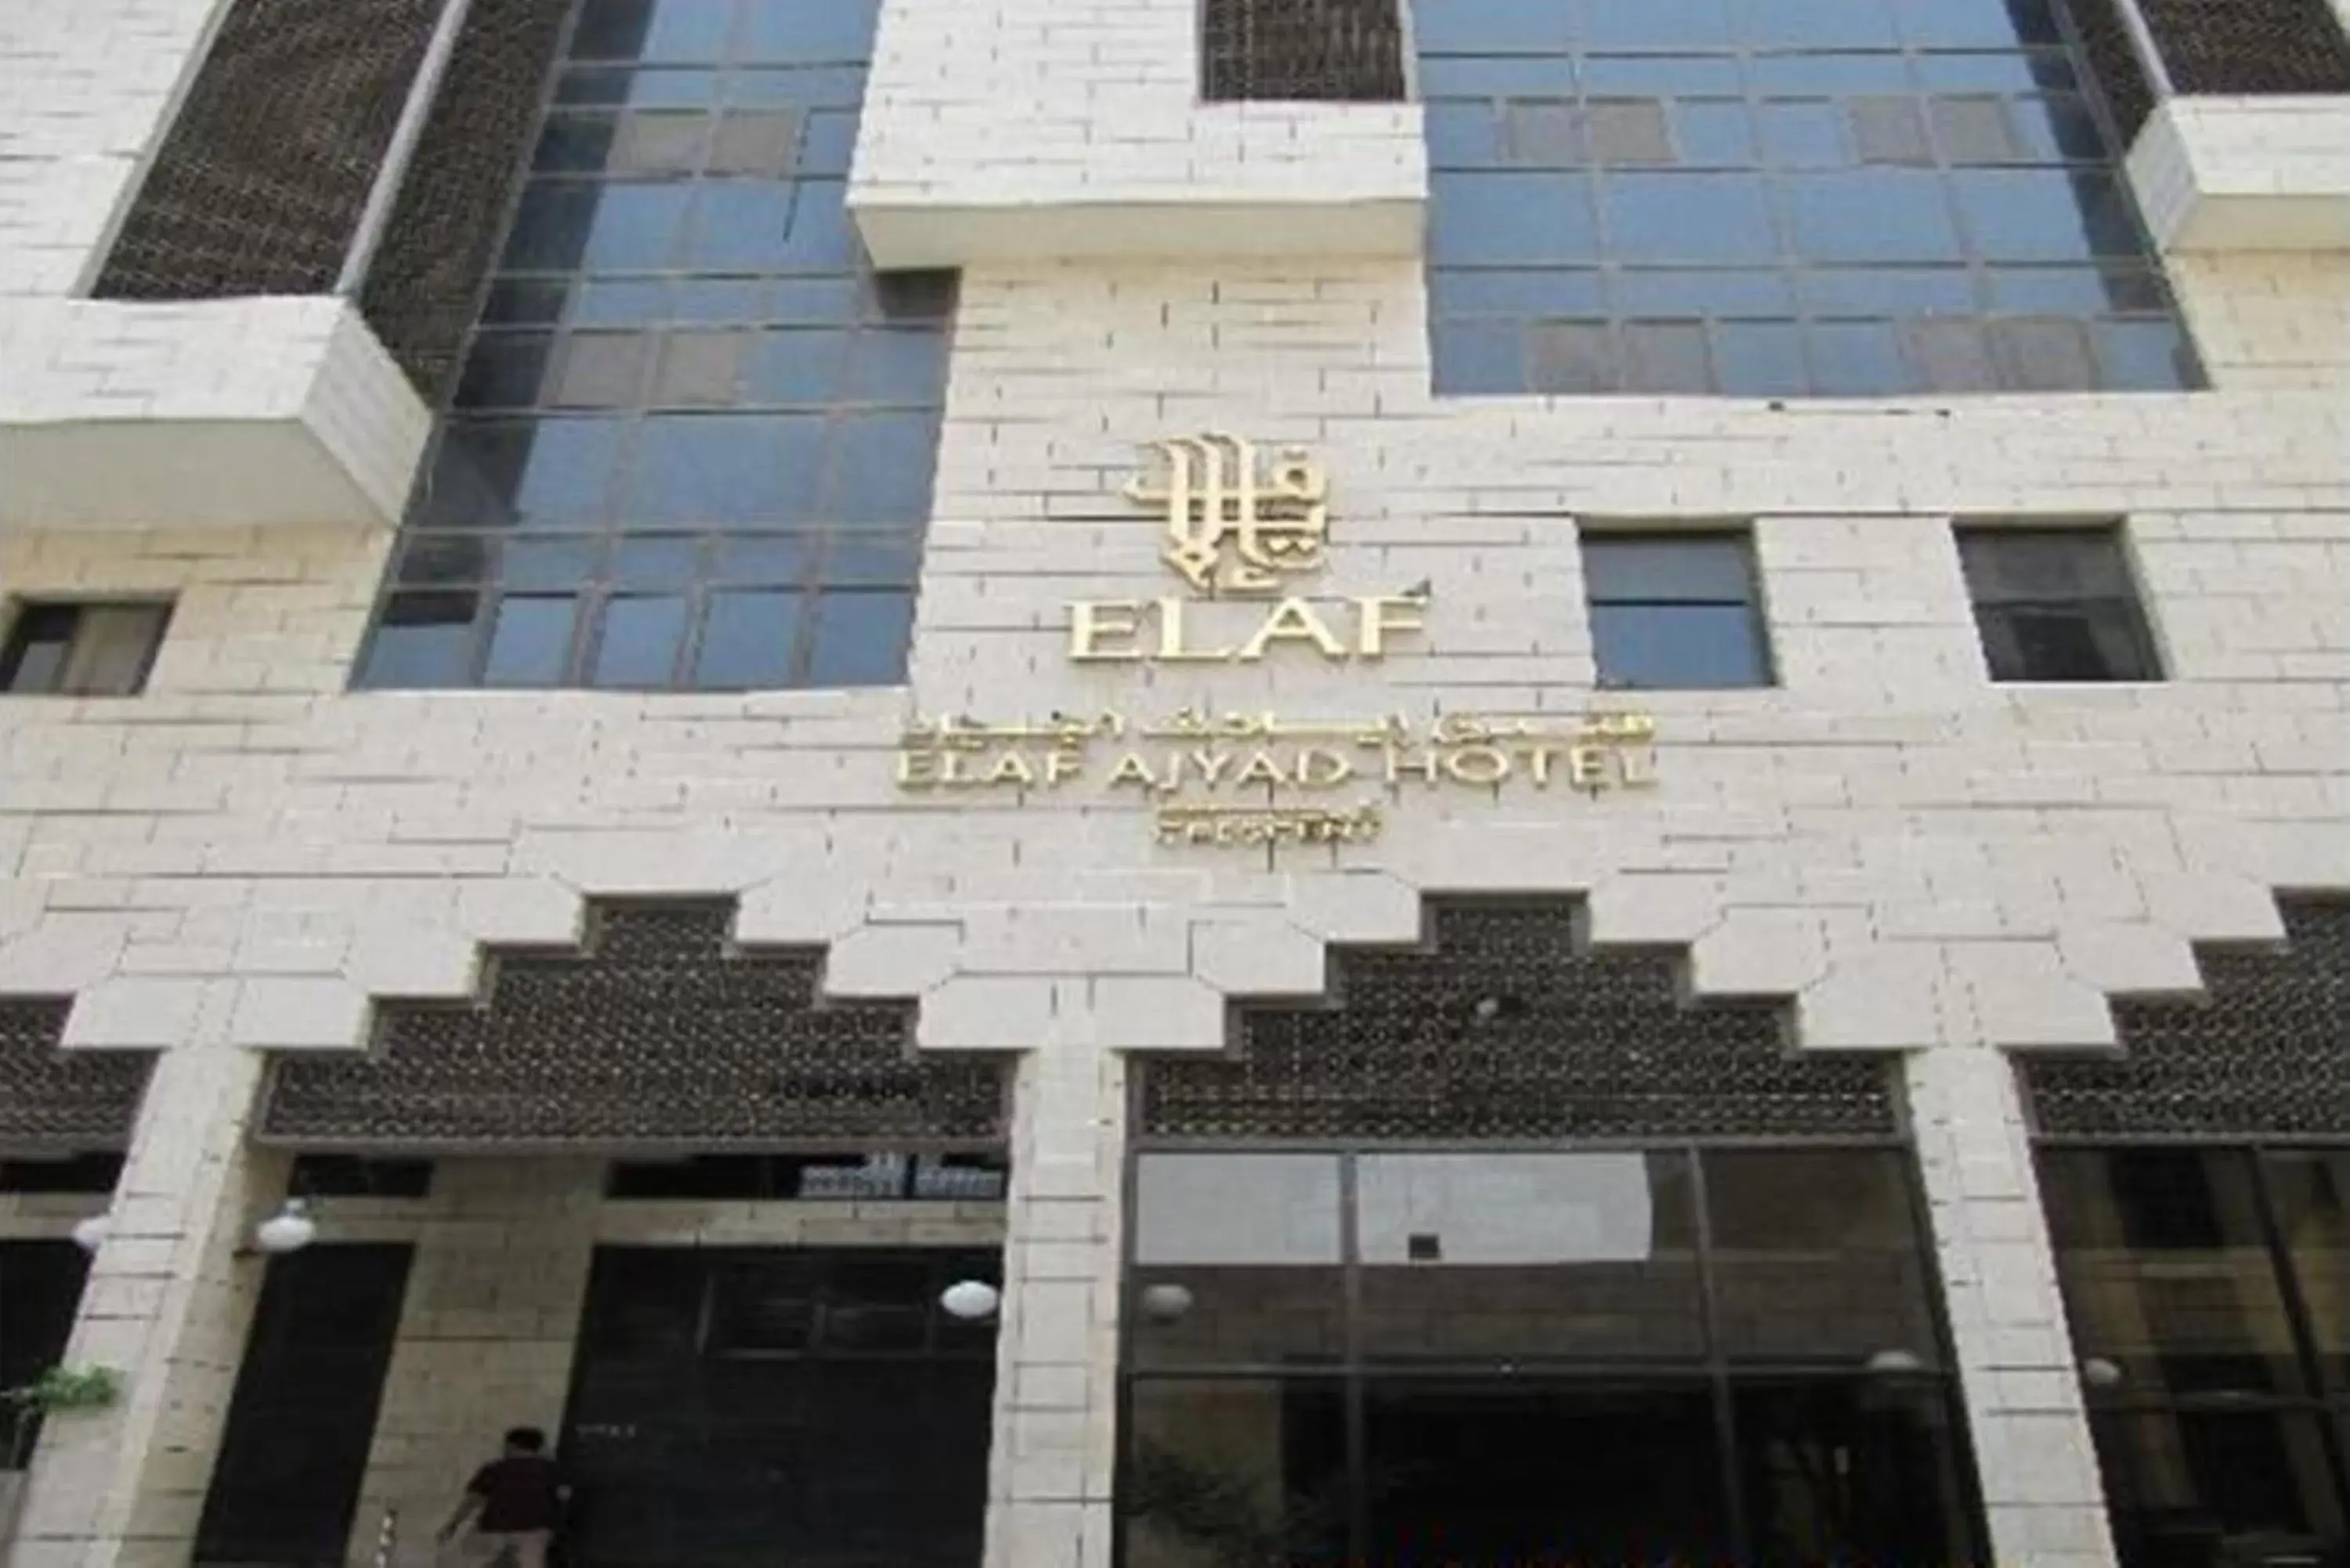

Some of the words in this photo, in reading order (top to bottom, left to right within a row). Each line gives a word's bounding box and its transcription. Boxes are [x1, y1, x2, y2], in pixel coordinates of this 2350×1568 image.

[1065, 595, 1430, 662] ELAF
[896, 749, 1083, 789] ELAF
[1108, 747, 1354, 794] AJYAD
[1385, 746, 1656, 788] HOTEL
